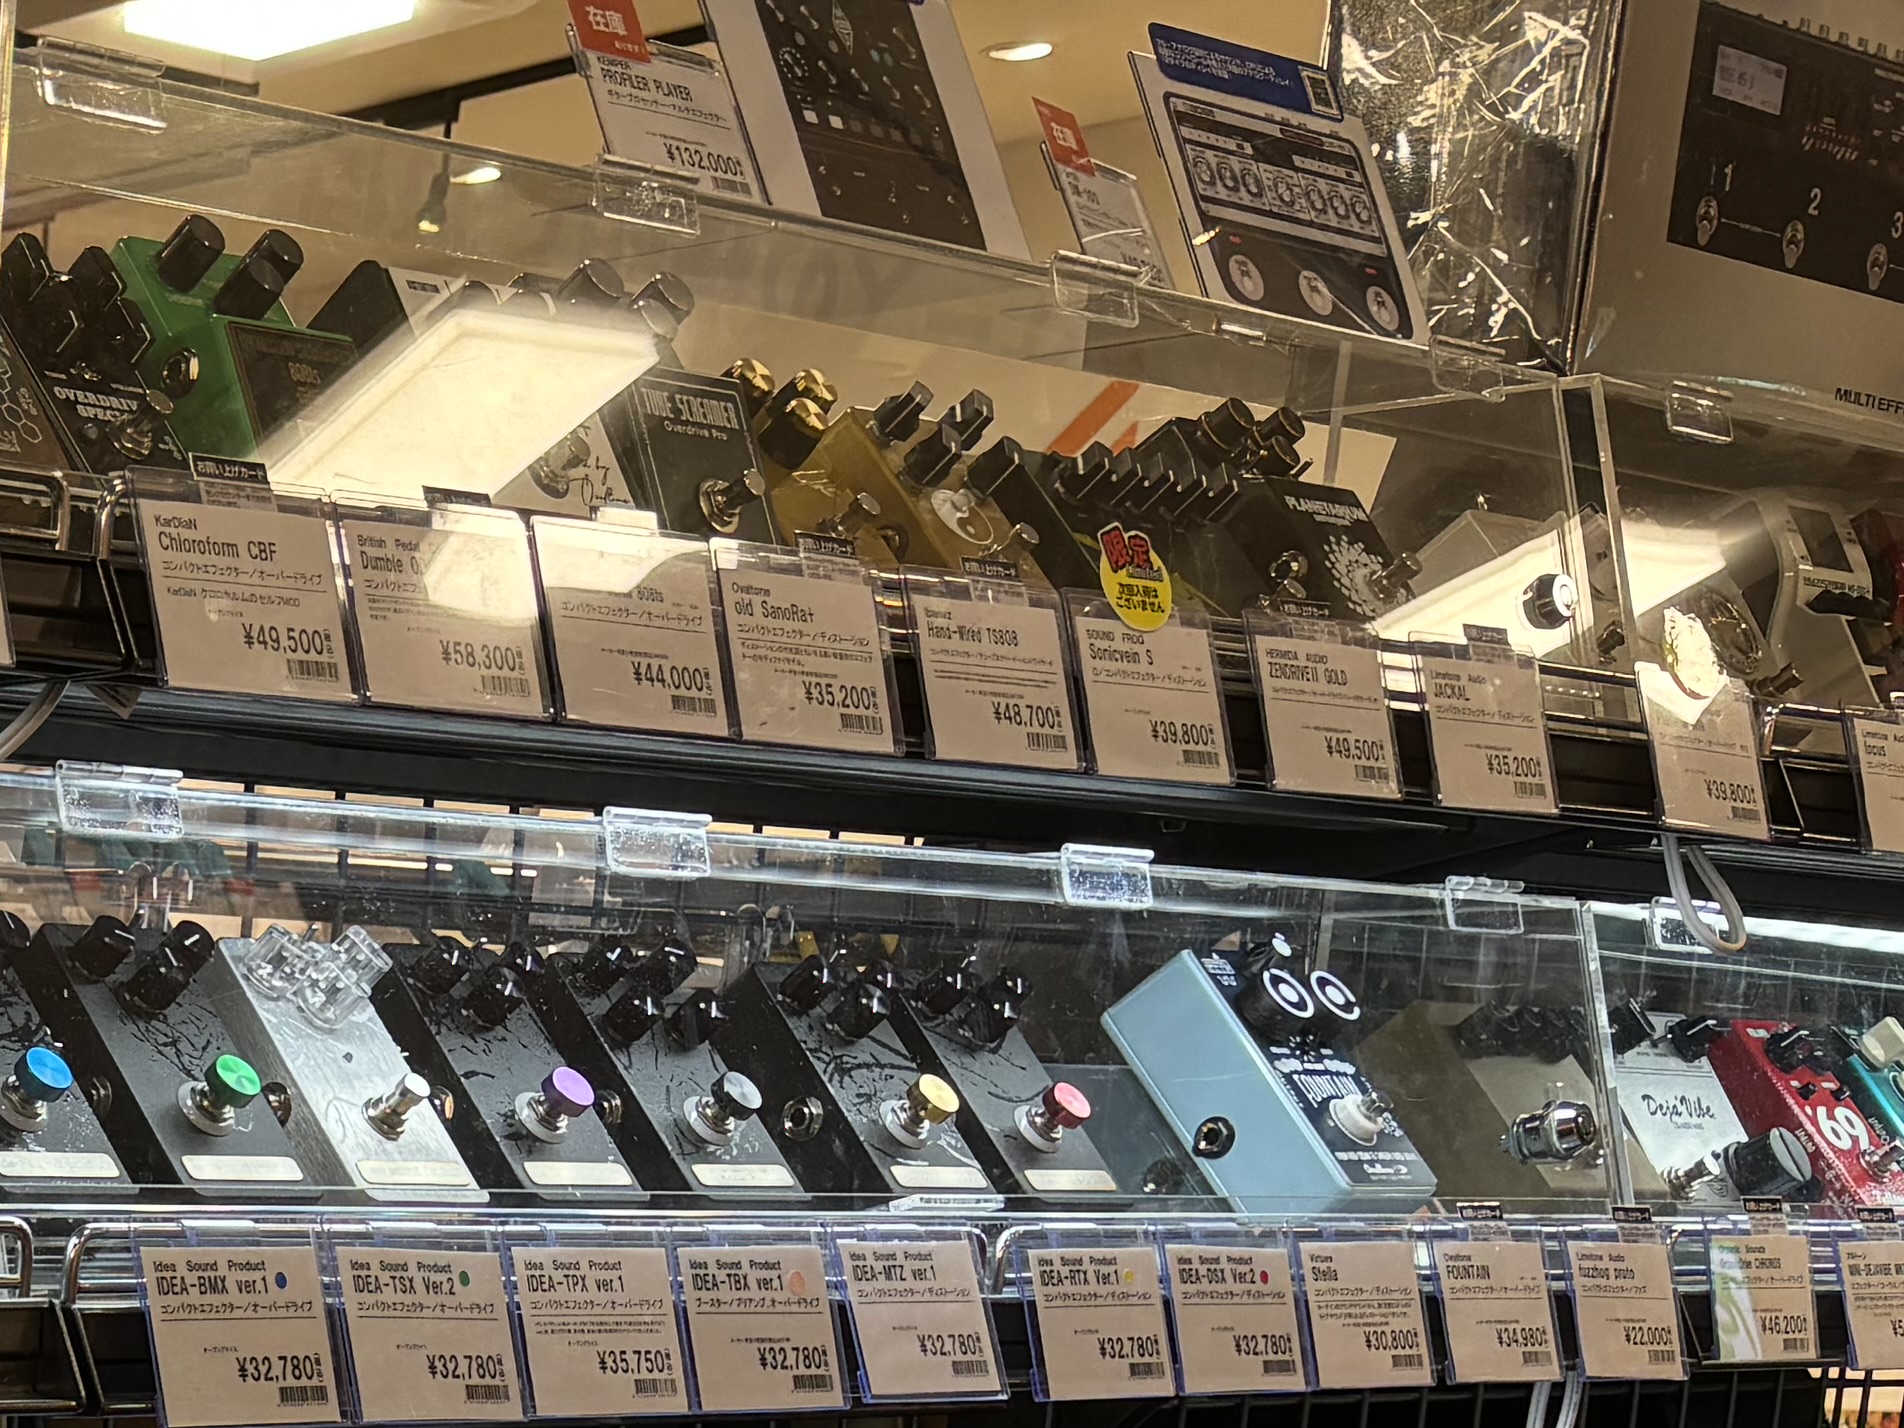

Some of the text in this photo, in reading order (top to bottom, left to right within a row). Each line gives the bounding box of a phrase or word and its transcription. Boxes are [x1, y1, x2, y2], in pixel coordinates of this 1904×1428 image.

[159, 531, 276, 561] Chloroform CBF
[736, 598, 754, 616] old
[243, 623, 323, 655] ¥49,500
[803, 681, 871, 711] ¥35,200
[993, 701, 1055, 730] ¥48,700
[157, 1272, 229, 1295] IDEA-BMX
[1497, 1326, 1547, 1350] ¥34,980
[237, 1356, 314, 1384] ¥32,780
